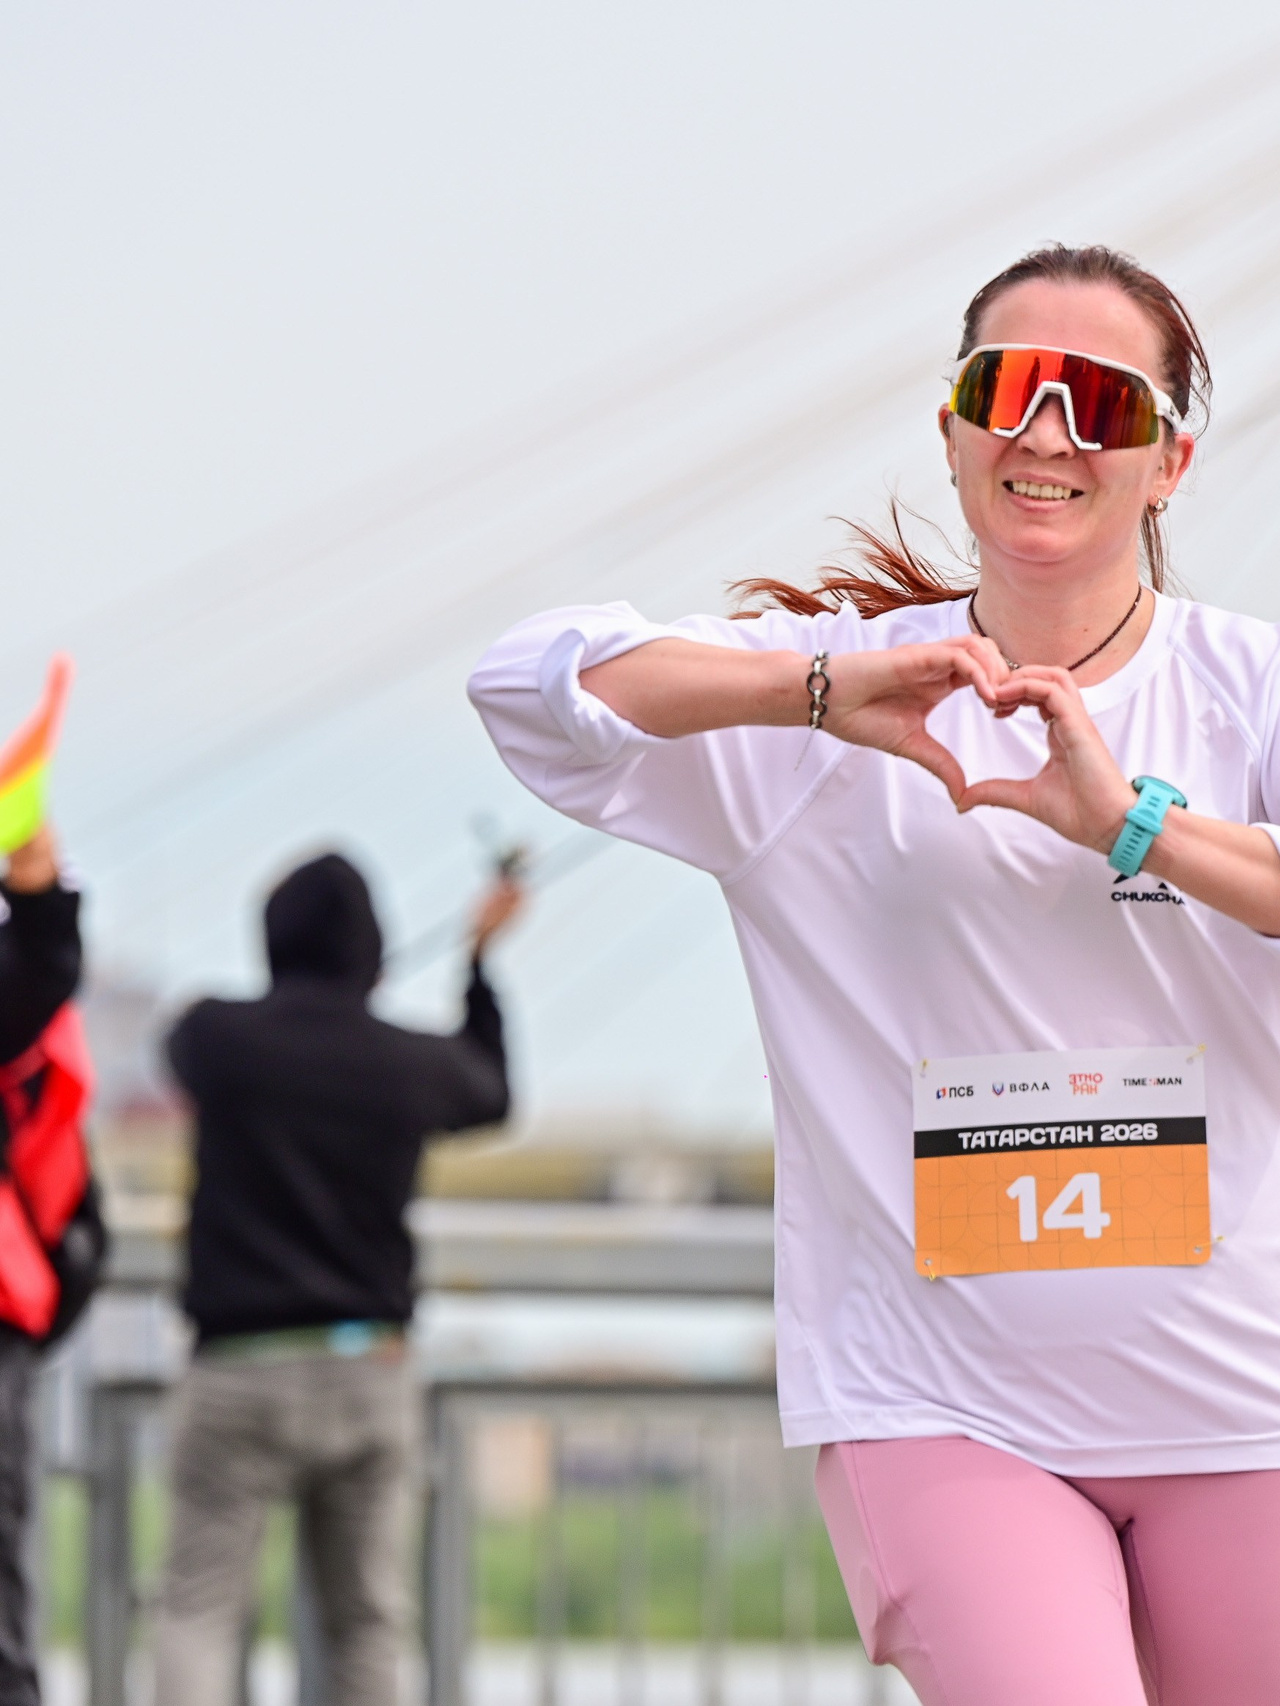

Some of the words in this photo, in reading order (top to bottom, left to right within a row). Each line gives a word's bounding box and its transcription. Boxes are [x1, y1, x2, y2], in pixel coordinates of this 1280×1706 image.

[1009, 1081, 1051, 1093] ВФЛА
[1068, 1072, 1103, 1087] ЭТНО
[948, 1085, 975, 1099] ПСБ
[958, 1125, 1094, 1150] ТАТАРСТАН
[1100, 1122, 1159, 1142] 2026
[1005, 1172, 1111, 1242] 14
